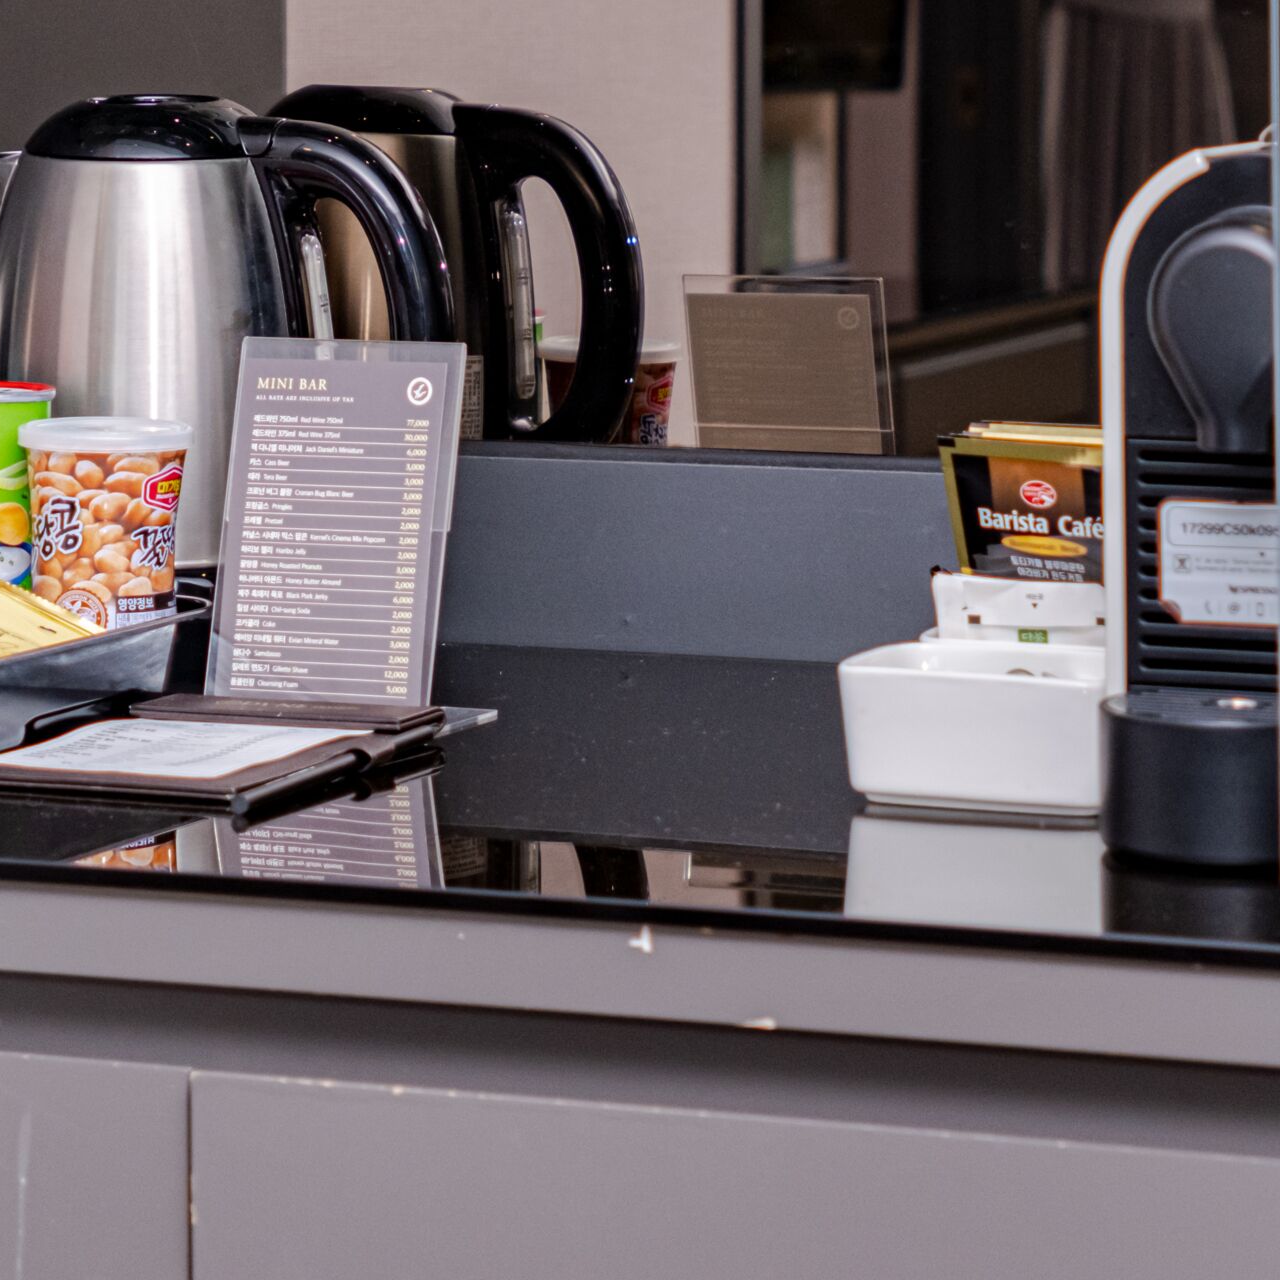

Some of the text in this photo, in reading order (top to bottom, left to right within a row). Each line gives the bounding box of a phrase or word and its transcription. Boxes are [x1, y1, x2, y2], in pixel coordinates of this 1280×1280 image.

[257, 377, 327, 391] MINI BAR
[977, 507, 1104, 538] Barista Café
[117, 596, 155, 612] 영양정보
